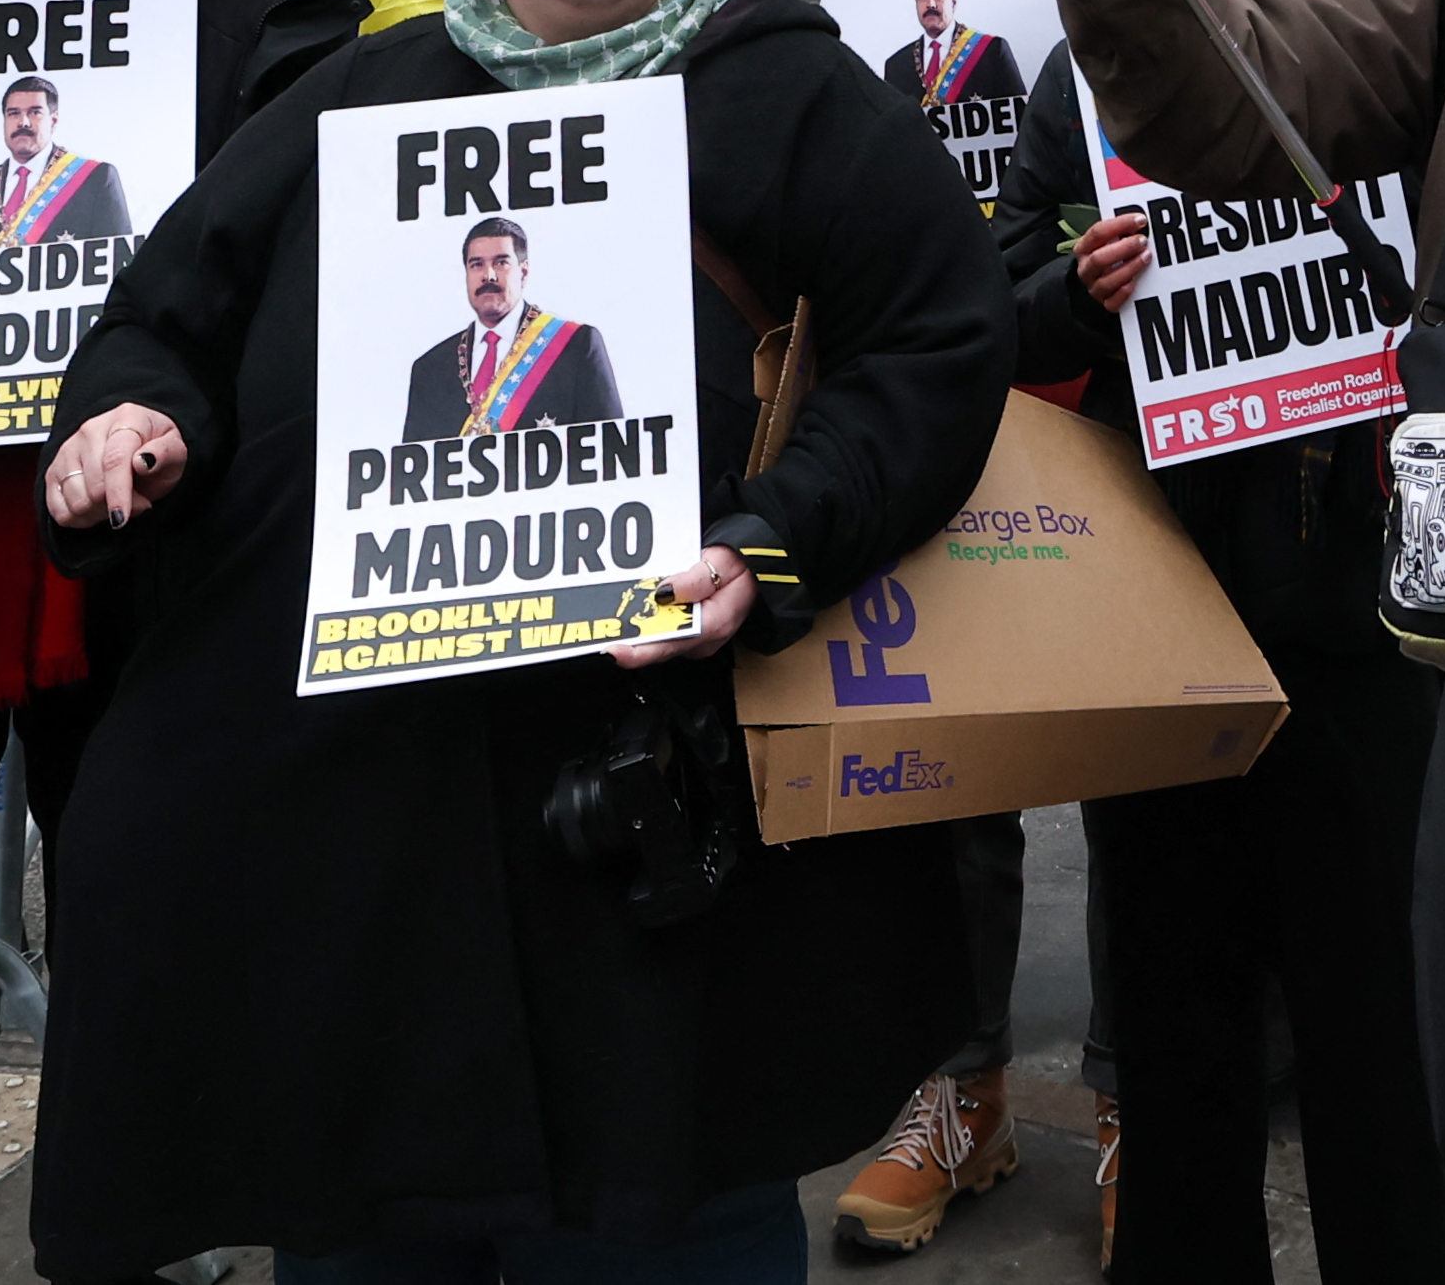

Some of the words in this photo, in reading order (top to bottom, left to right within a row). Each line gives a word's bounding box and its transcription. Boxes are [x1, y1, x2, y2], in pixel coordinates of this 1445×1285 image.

[396, 114, 608, 222] FREE
[1277, 380, 1342, 405] Freedom
[1343, 368, 1383, 389] Road
[1280, 395, 1342, 422] Socialist
[1344, 382, 1406, 411] Organiza
[1152, 394, 1267, 452] FRSO
[346, 414, 673, 510] PRESIDENT
[1035, 505, 1095, 537] Box
[352, 501, 654, 598] MADURO
[947, 541, 1028, 566] Recycle
[1032, 545, 1070, 560] me.
[316, 596, 553, 644] BROOKLYN
[311, 630, 512, 675] AGAINST
[520, 617, 622, 650] WAR
[840, 750, 946, 797] FedEx
